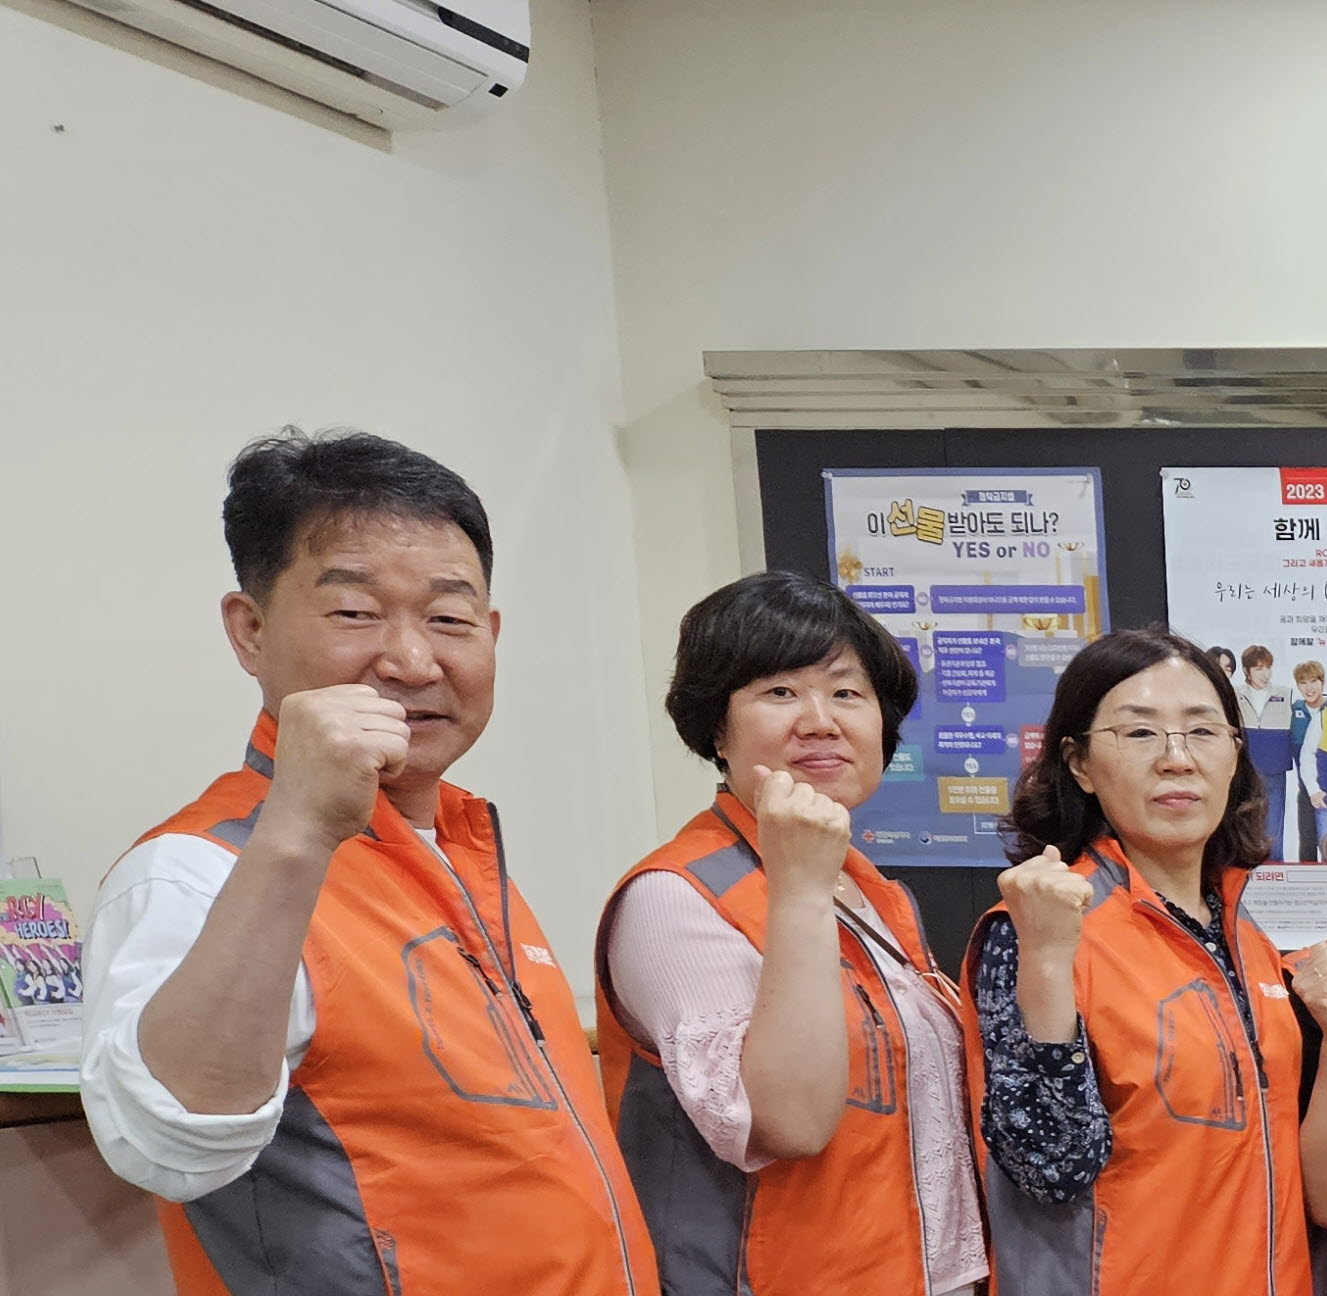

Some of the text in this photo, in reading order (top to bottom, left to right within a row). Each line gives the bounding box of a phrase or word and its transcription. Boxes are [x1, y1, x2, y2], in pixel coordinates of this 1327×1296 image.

[1286, 483, 1325, 500] 2023
[867, 498, 1060, 545] 이 선물 받아도 되나?
[1273, 517, 1320, 541] 함께
[952, 541, 1050, 558] YES or NO
[864, 567, 895, 577] START
[1213, 581, 1255, 602] 우리는
[1263, 581, 1315, 601] 세상의
[15, 921, 71, 940] HEROES!
